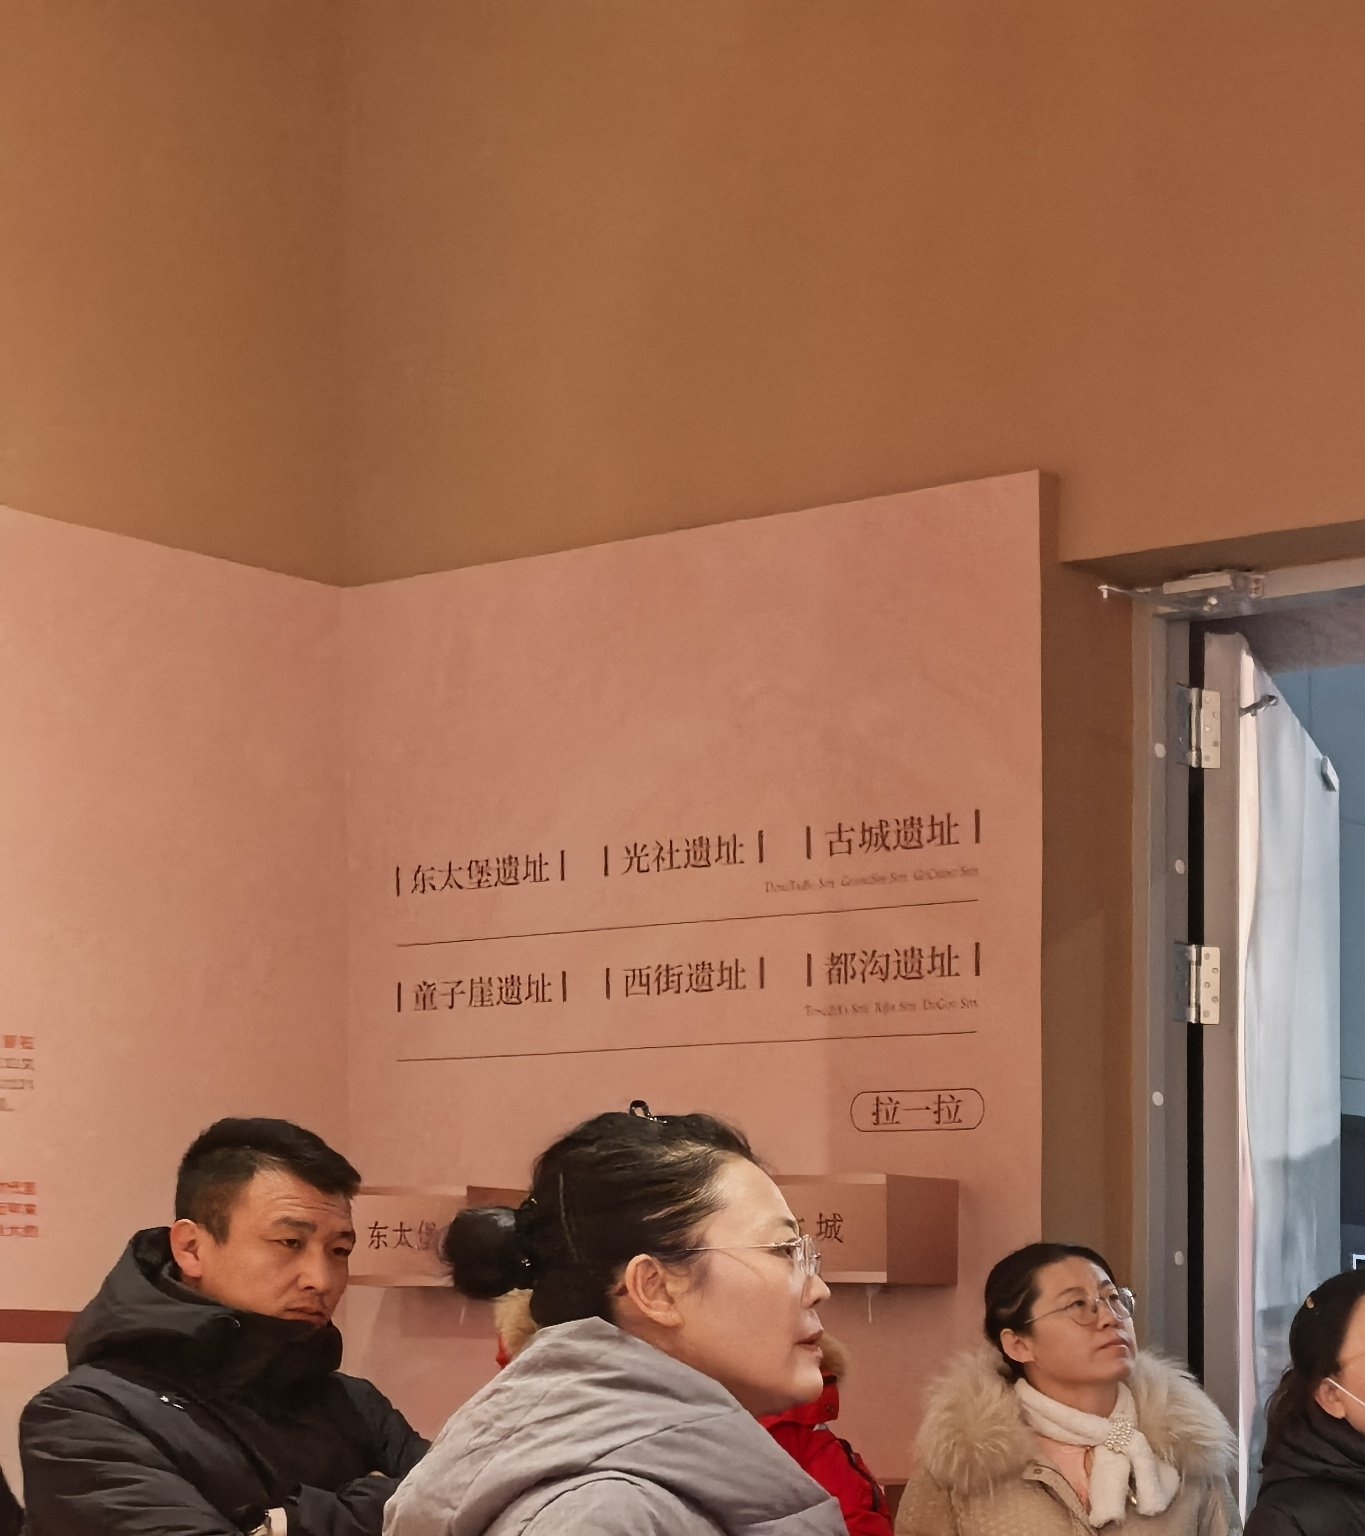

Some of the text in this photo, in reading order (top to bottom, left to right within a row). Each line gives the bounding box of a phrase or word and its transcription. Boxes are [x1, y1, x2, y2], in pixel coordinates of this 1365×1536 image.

[411, 812, 960, 895] 东太堡遗址 光社遗址 古城遗址
[413, 944, 960, 1011] 童子崖遗址 西街遗址 都沟遗址
[871, 1094, 963, 1126] 拉一拉
